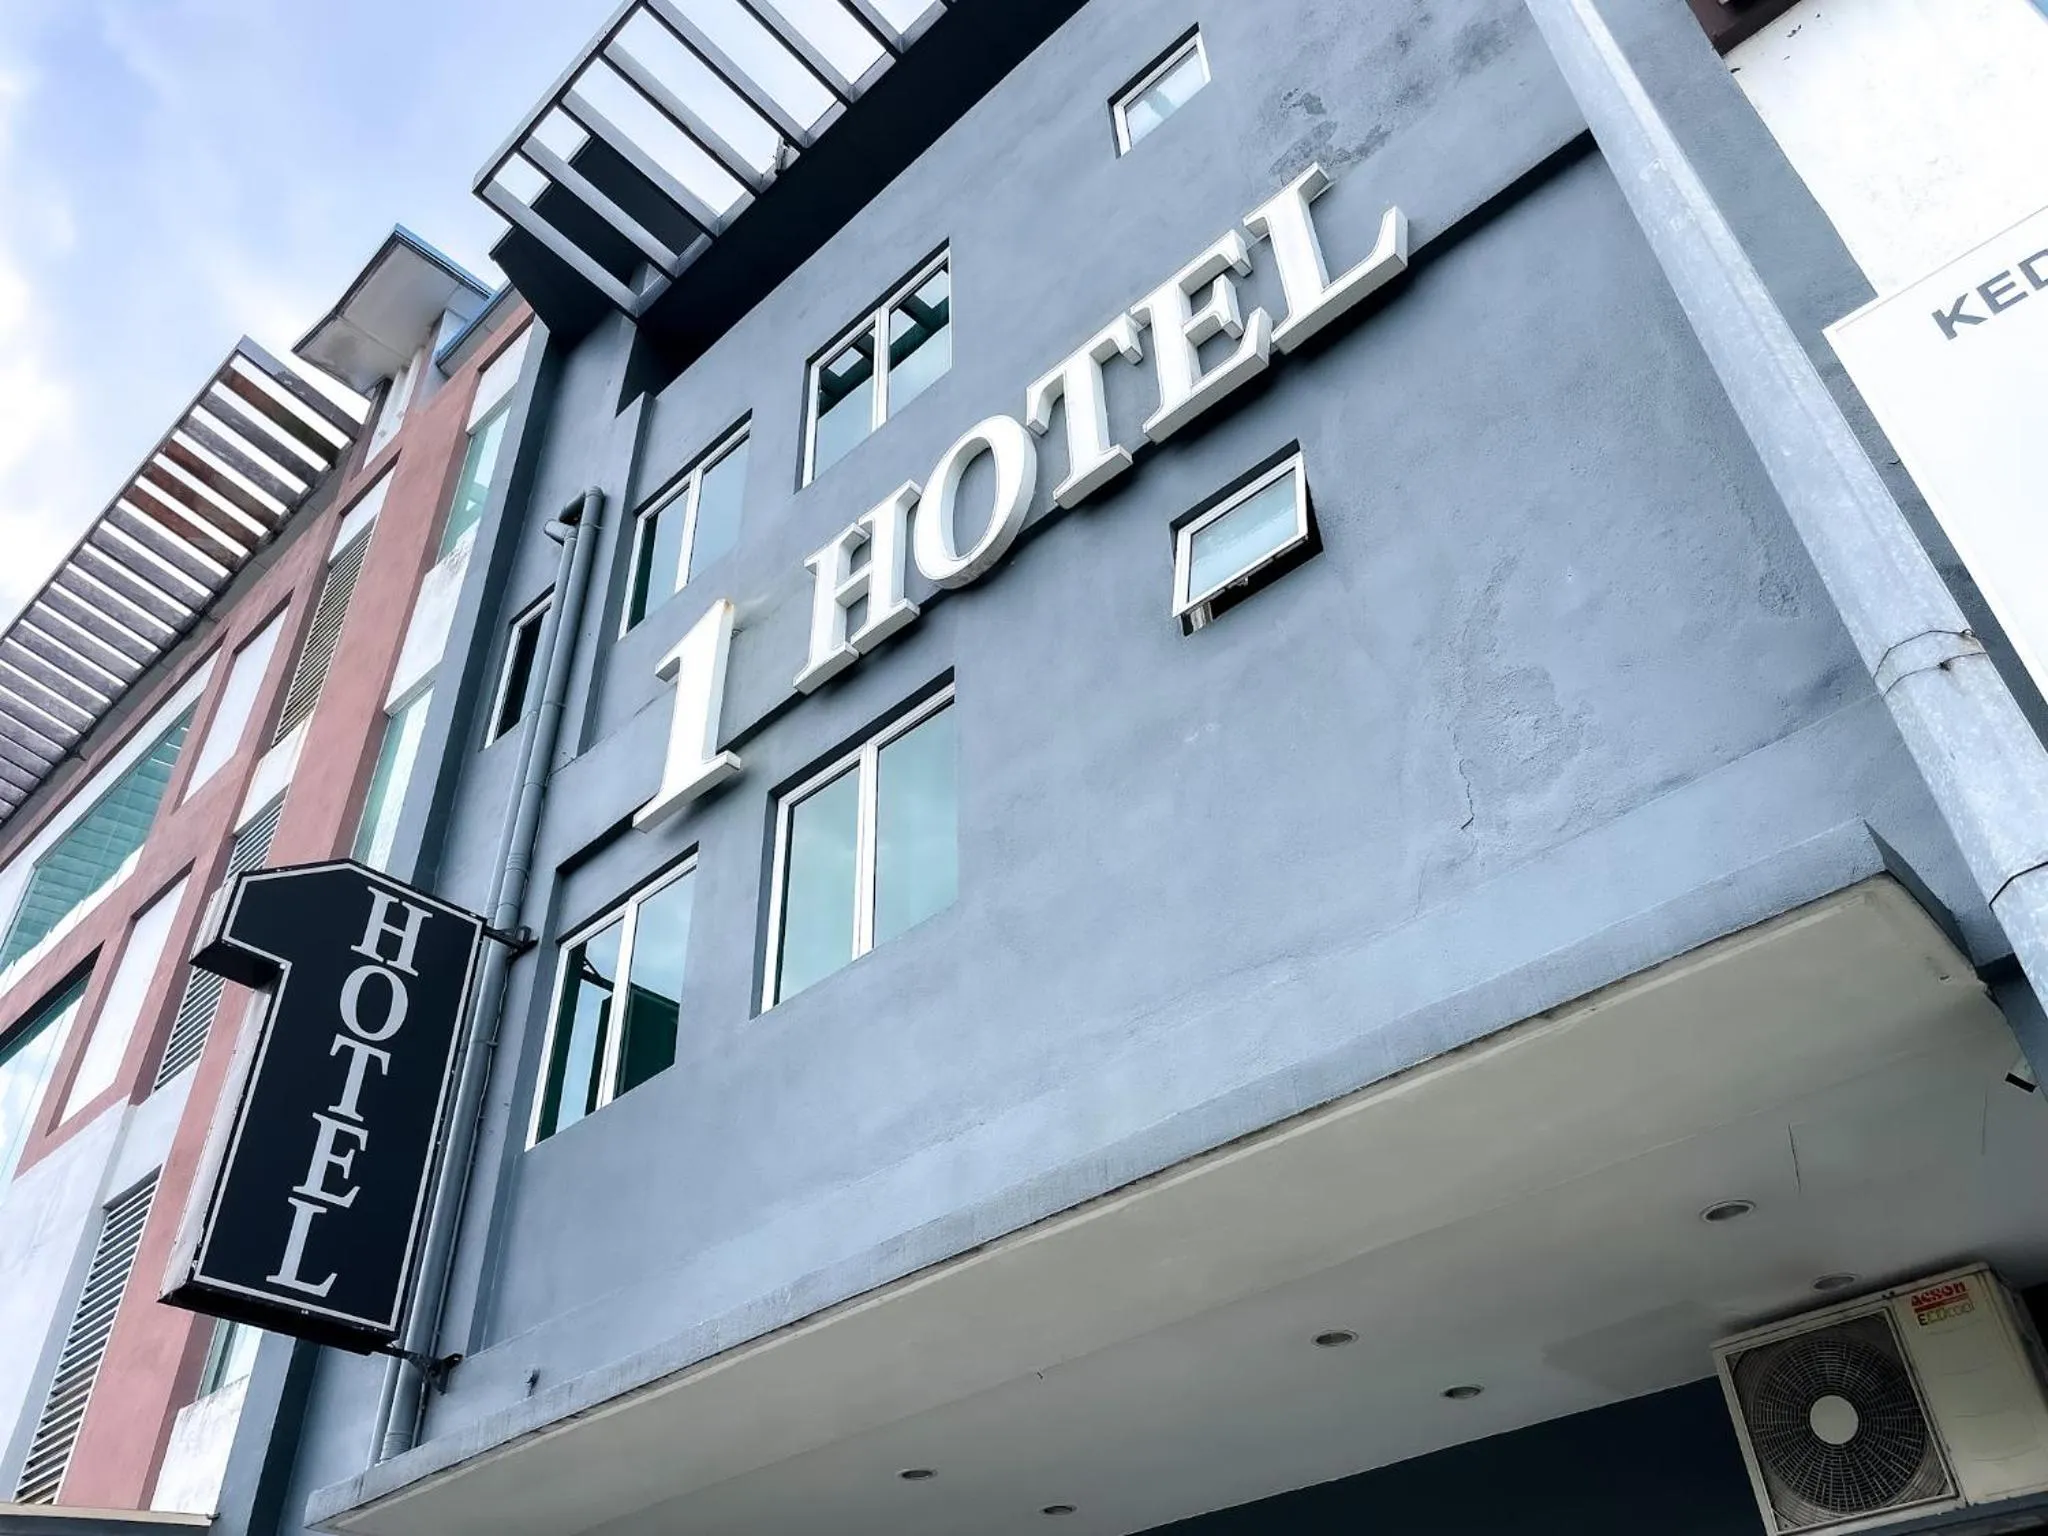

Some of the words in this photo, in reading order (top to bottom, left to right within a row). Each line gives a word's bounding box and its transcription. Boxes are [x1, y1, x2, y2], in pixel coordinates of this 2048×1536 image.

[632, 598, 741, 832] 1
[792, 162, 1408, 694] HOTEL
[266, 885, 434, 1298] HOTEL
